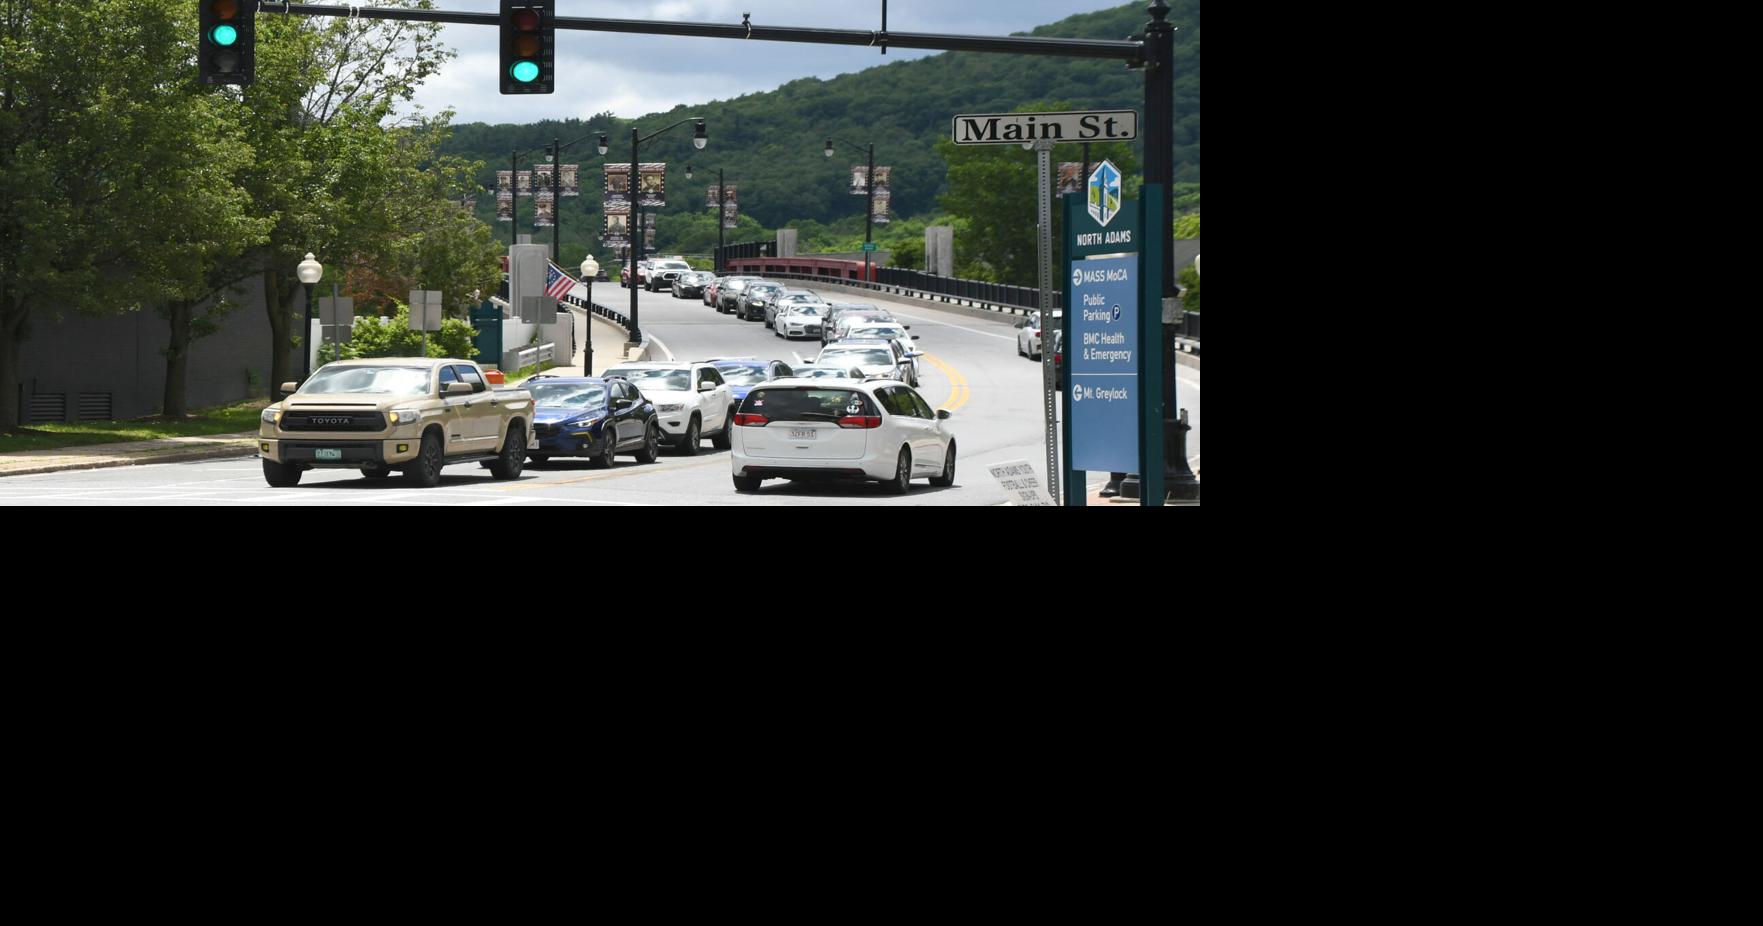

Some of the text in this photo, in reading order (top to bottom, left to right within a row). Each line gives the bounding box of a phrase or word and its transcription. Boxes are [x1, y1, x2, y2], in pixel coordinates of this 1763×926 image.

[962, 115, 1129, 141] Main St.
[1077, 230, 1131, 246] NORTH ADAMS
[1084, 269, 1128, 282] MASS MoCA
[1083, 293, 1105, 305] Public
[1083, 309, 1111, 323] Parking
[1084, 332, 1124, 345] BMC Health
[1083, 348, 1132, 362] & Emergency
[1096, 387, 1128, 402] Greylock
